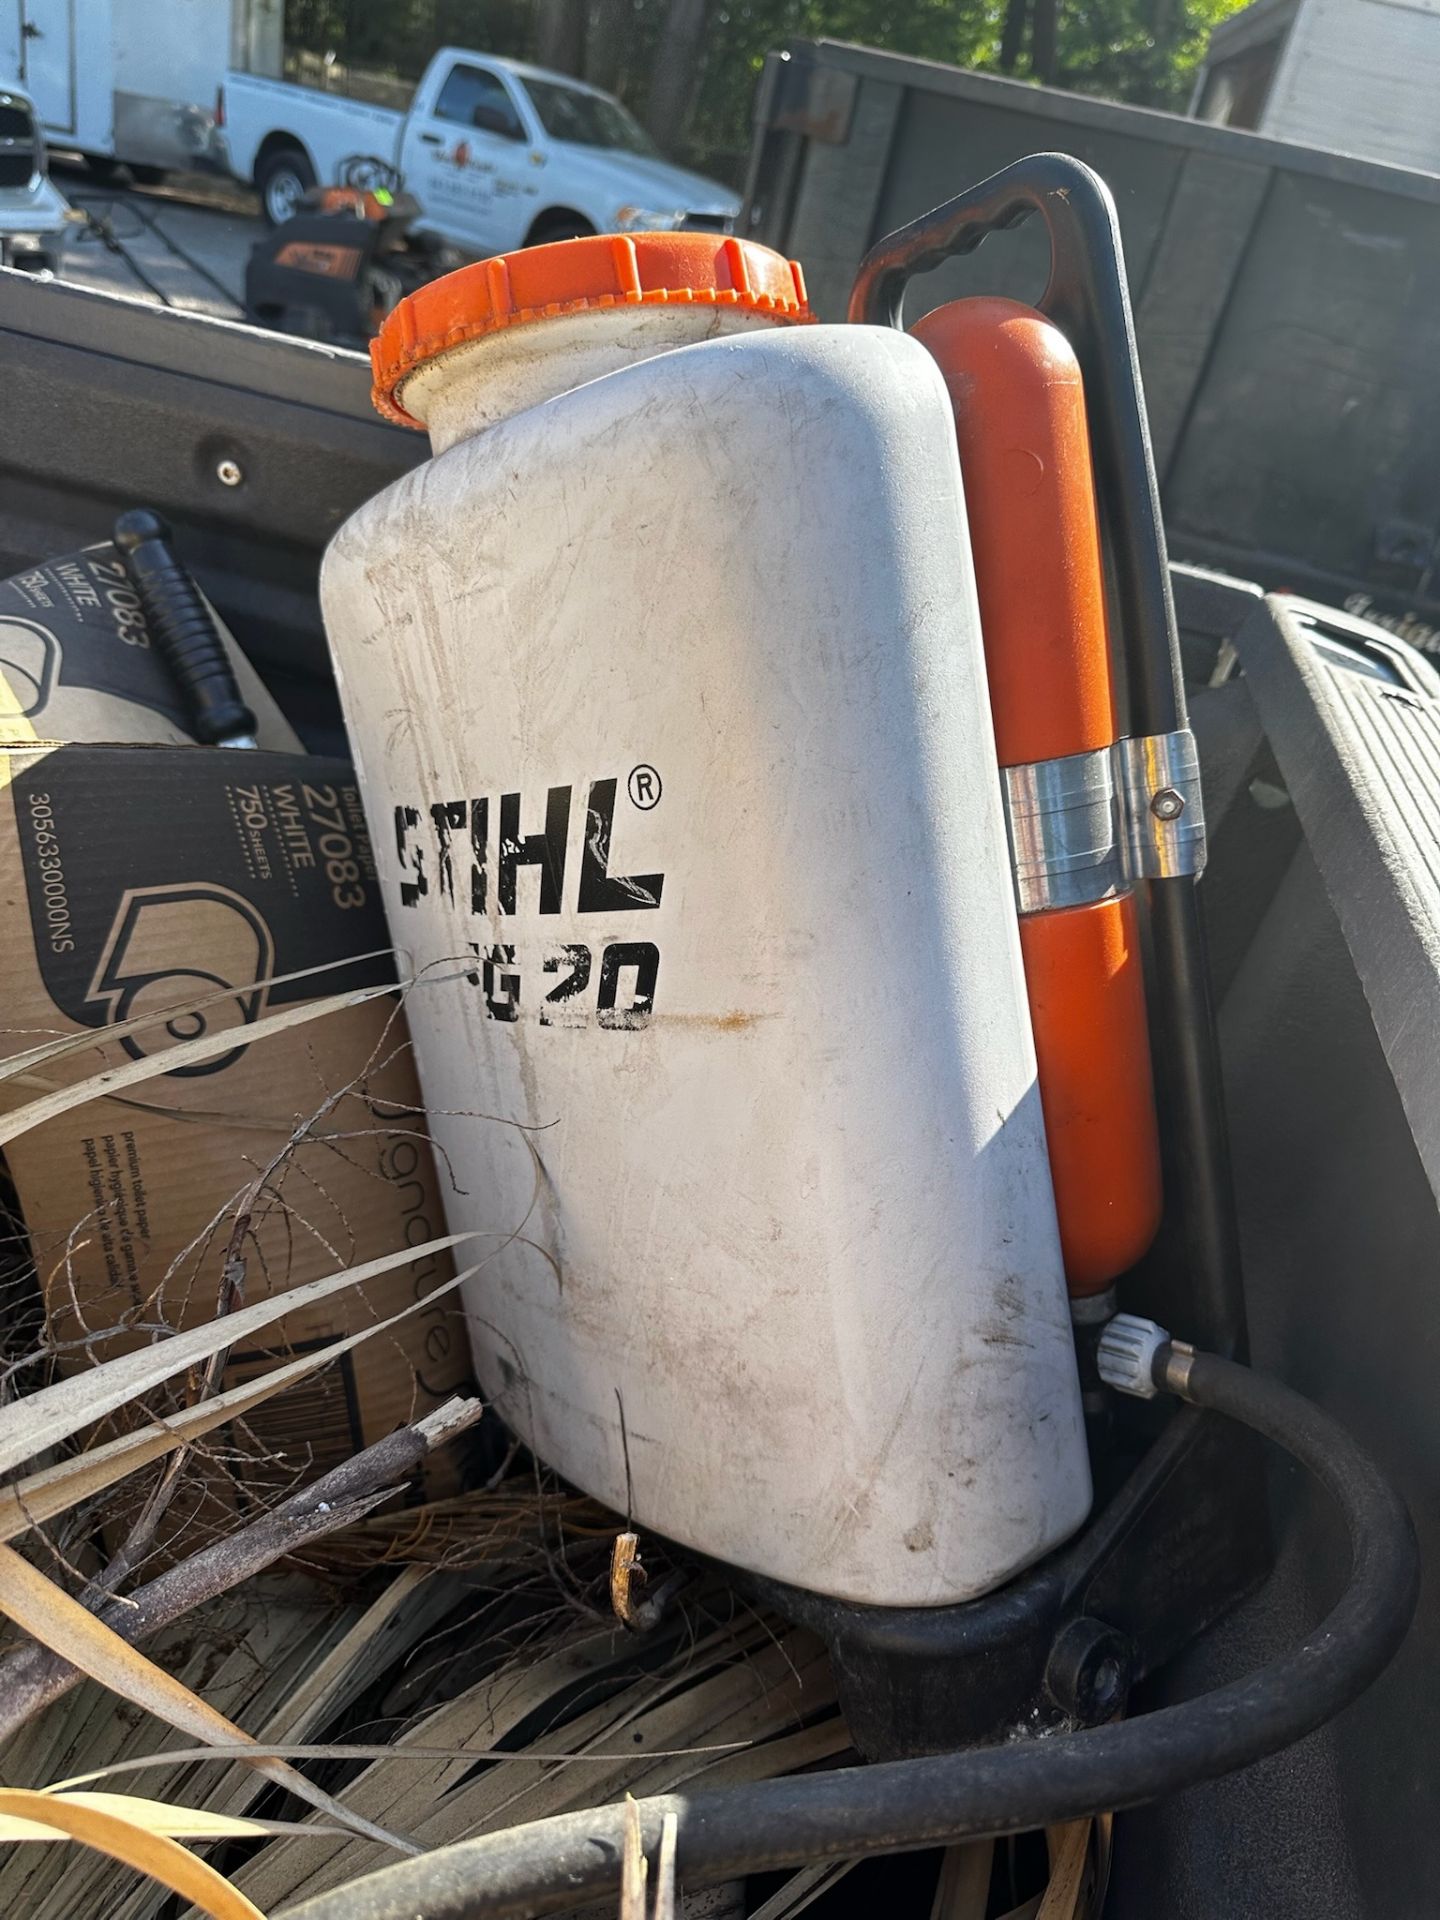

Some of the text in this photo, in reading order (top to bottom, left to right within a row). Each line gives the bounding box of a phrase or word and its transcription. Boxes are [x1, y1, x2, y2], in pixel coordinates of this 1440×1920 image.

[55, 562, 102, 608] WHITE
[87, 561, 150, 648] 27083
[236, 785, 273, 879] 750 SHEETS
[272, 784, 316, 868] WHITE
[302, 784, 366, 909] 27083
[29, 793, 75, 953] 3056330000NS
[538, 942, 660, 1031] 20
[80, 1138, 102, 1168] papel
[100, 1134, 121, 1168] papier
[120, 1131, 151, 1239] premium toilet paper
